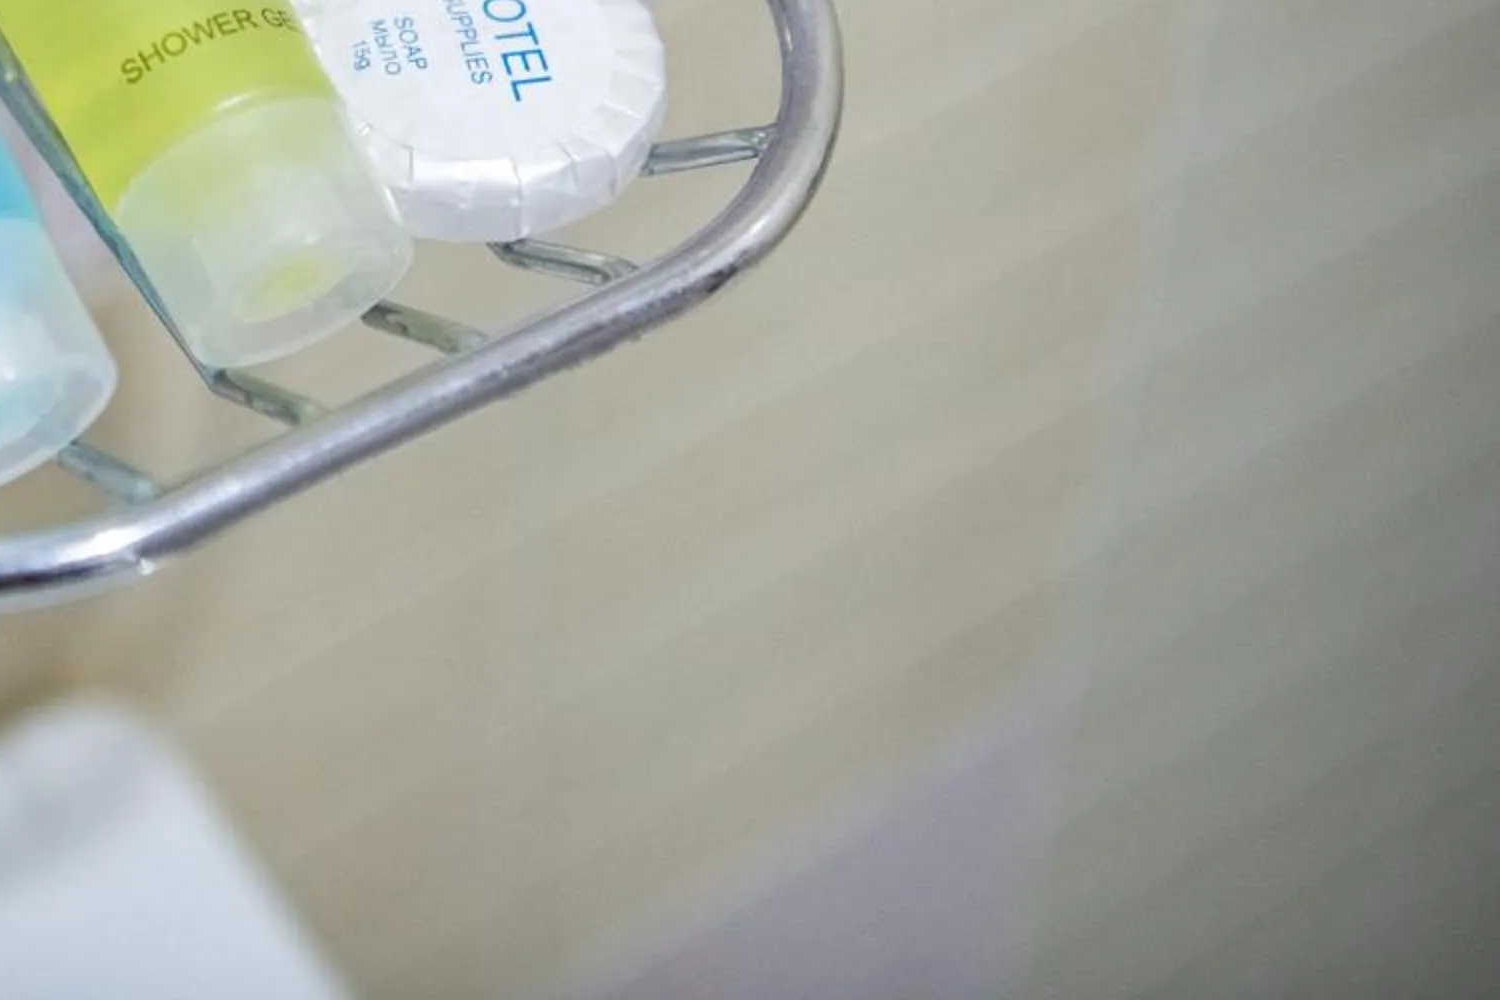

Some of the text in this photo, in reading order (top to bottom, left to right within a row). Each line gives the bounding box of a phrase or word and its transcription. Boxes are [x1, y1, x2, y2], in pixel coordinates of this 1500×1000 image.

[120, 8, 260, 85] SHOWER
[352, 40, 371, 72] 15g
[394, 17, 428, 70] SOAP
